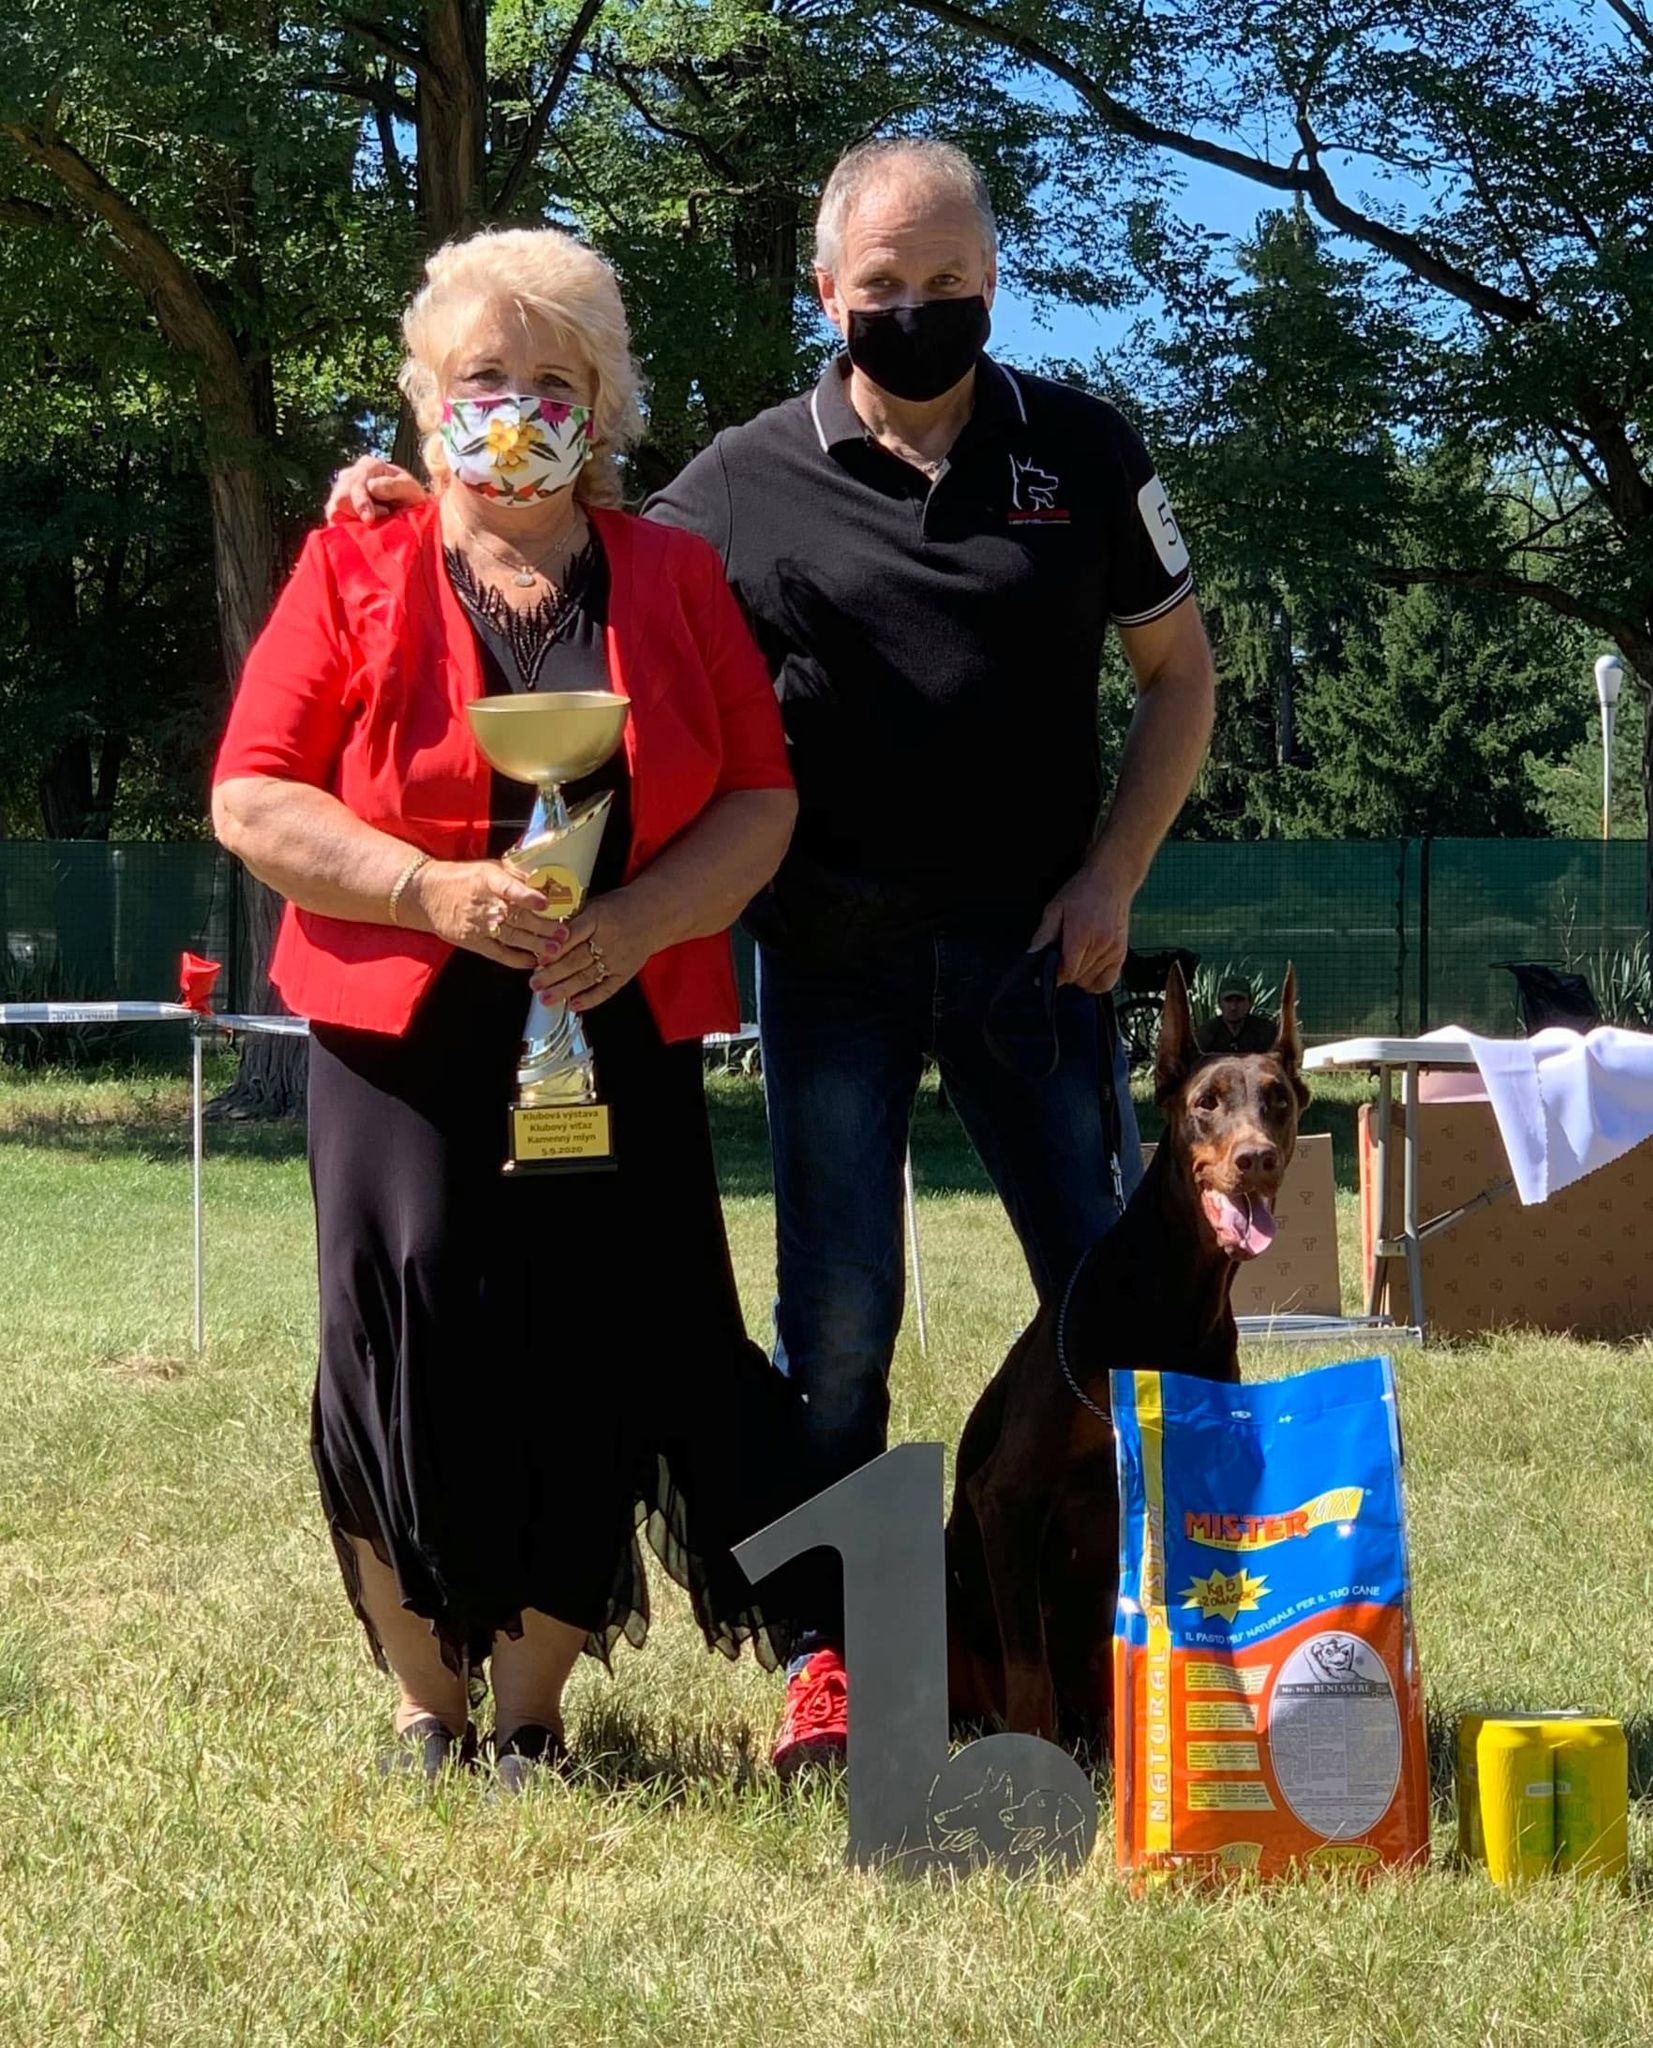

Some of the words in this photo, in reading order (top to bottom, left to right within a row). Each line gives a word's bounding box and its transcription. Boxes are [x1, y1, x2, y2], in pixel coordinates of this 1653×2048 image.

[1157, 502, 1179, 546] 5
[530, 1123, 567, 1132] Klubový
[563, 1110, 599, 1120] výstava
[1184, 1510, 1310, 1543] MISTER
[1185, 1632, 1194, 1641] IL
[1196, 1632, 1225, 1644] PASTO
[1246, 1607, 1296, 1639] NATURALE
[1296, 1596, 1317, 1613] PER
[1317, 1594, 1327, 1603] IL
[1328, 1587, 1349, 1600] TUO
[1352, 1585, 1381, 1596] CANE
[1313, 1684, 1370, 1694] BENESSERE
[1150, 1647, 1168, 1822] NATURAL
